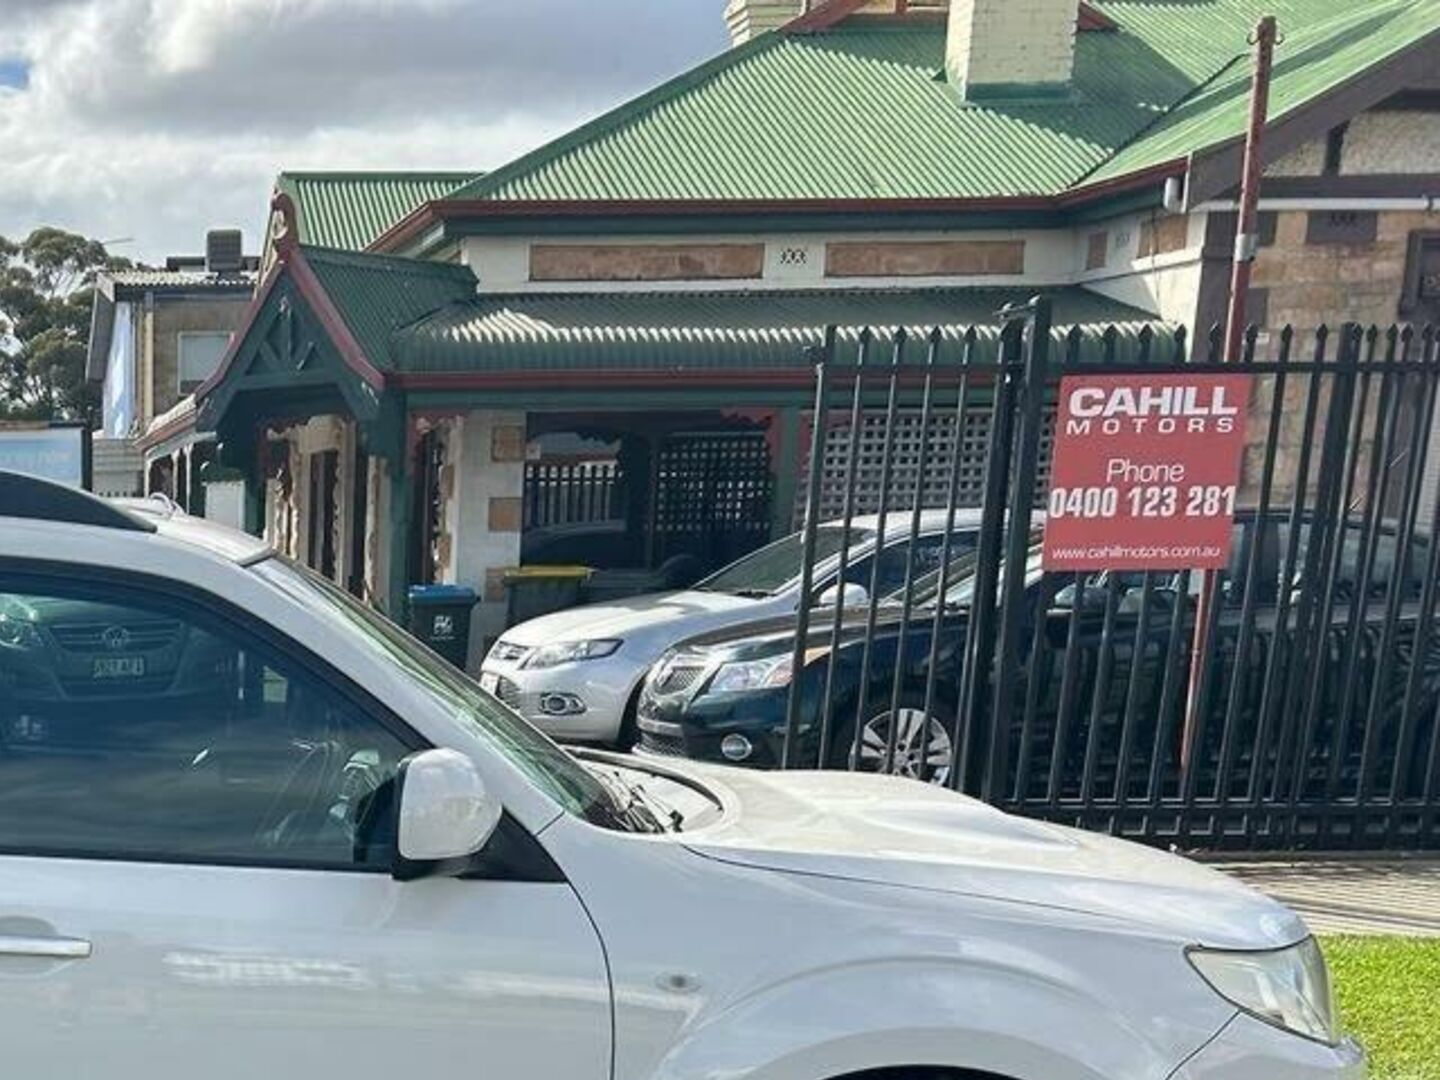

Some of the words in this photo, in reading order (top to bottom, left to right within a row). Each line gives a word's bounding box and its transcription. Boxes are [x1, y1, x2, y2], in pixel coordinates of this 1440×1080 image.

[1068, 386, 1239, 417] CAHILL
[1065, 417, 1234, 435] MOTORS
[1106, 458, 1185, 483] Phone
[1049, 487, 1119, 518] 0400
[1128, 486, 1177, 517] 123
[1185, 485, 1237, 517] 281
[1051, 543, 1221, 560] www.cahillmotors.com.au
